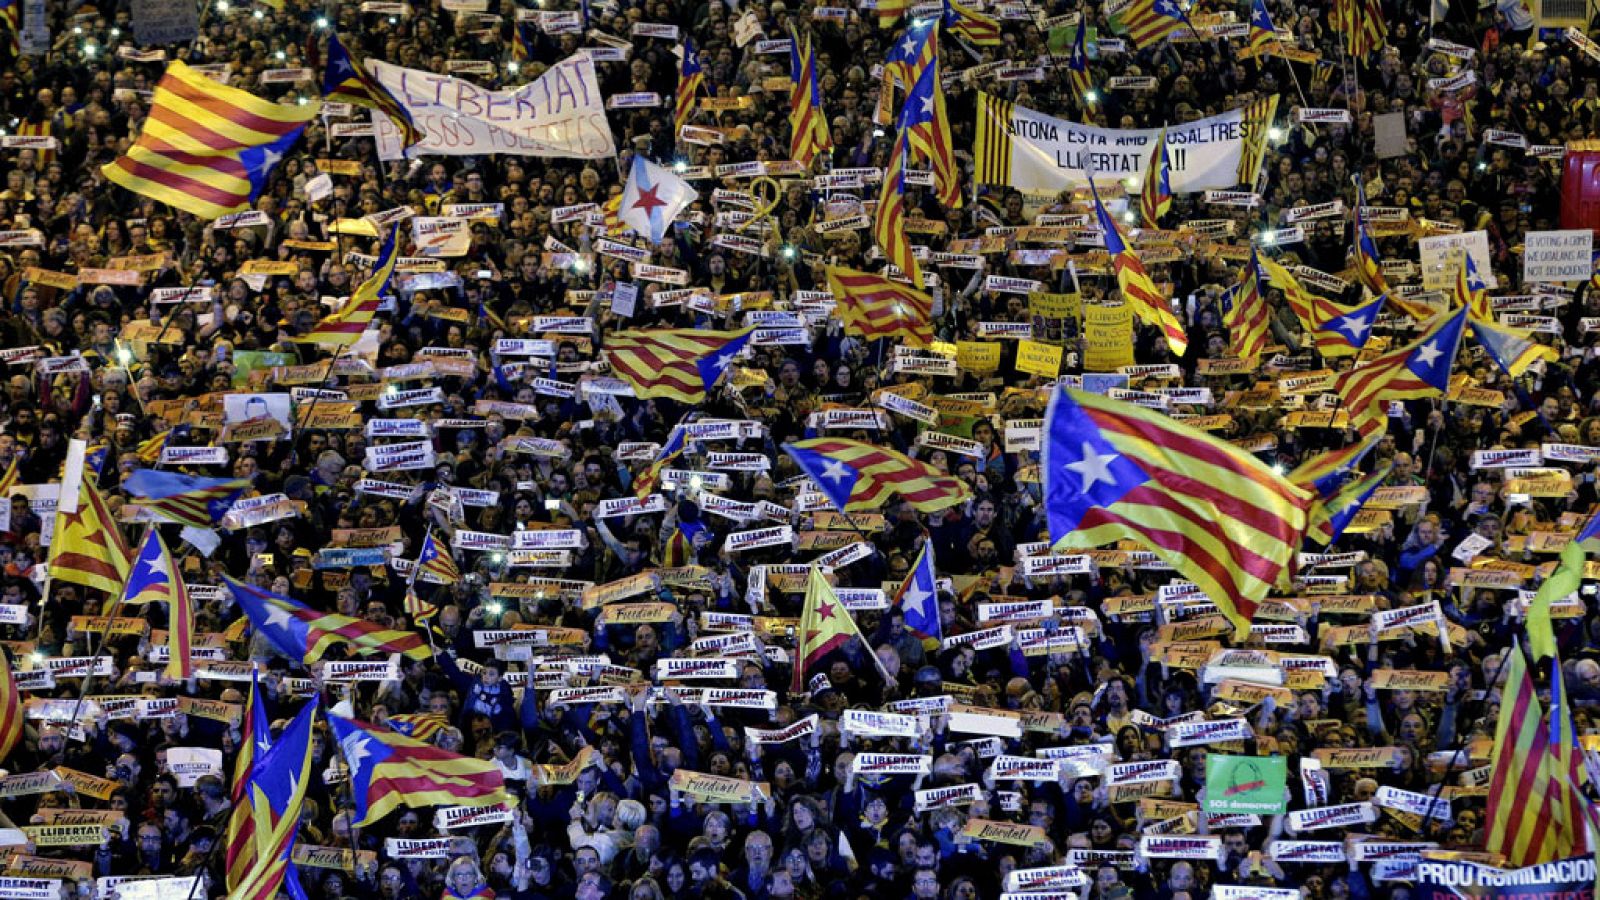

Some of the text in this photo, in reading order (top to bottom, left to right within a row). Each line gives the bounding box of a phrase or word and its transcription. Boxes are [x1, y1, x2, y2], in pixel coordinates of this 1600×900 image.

[1482, 450, 1531, 459] LLIBERTAT
[731, 528, 782, 543] LLIBERTAT
[1031, 557, 1084, 567] LLIBERTAT
[989, 603, 1042, 614] LLIBERTAT
[484, 632, 537, 640] LLIBERTAT
[331, 663, 388, 672] LLIBERTAT
[669, 661, 725, 669] LLIBERTAT
[709, 691, 764, 700] LLIBERTAT
[861, 756, 921, 764] LLIBERTAT
[997, 760, 1053, 770] LLIBERTAT
[1113, 762, 1167, 775] LLIBERTAT
[1300, 805, 1361, 822] LLIBERTAT
[41, 826, 100, 836] LLIBERTAT
[1418, 863, 1472, 886] PROU
